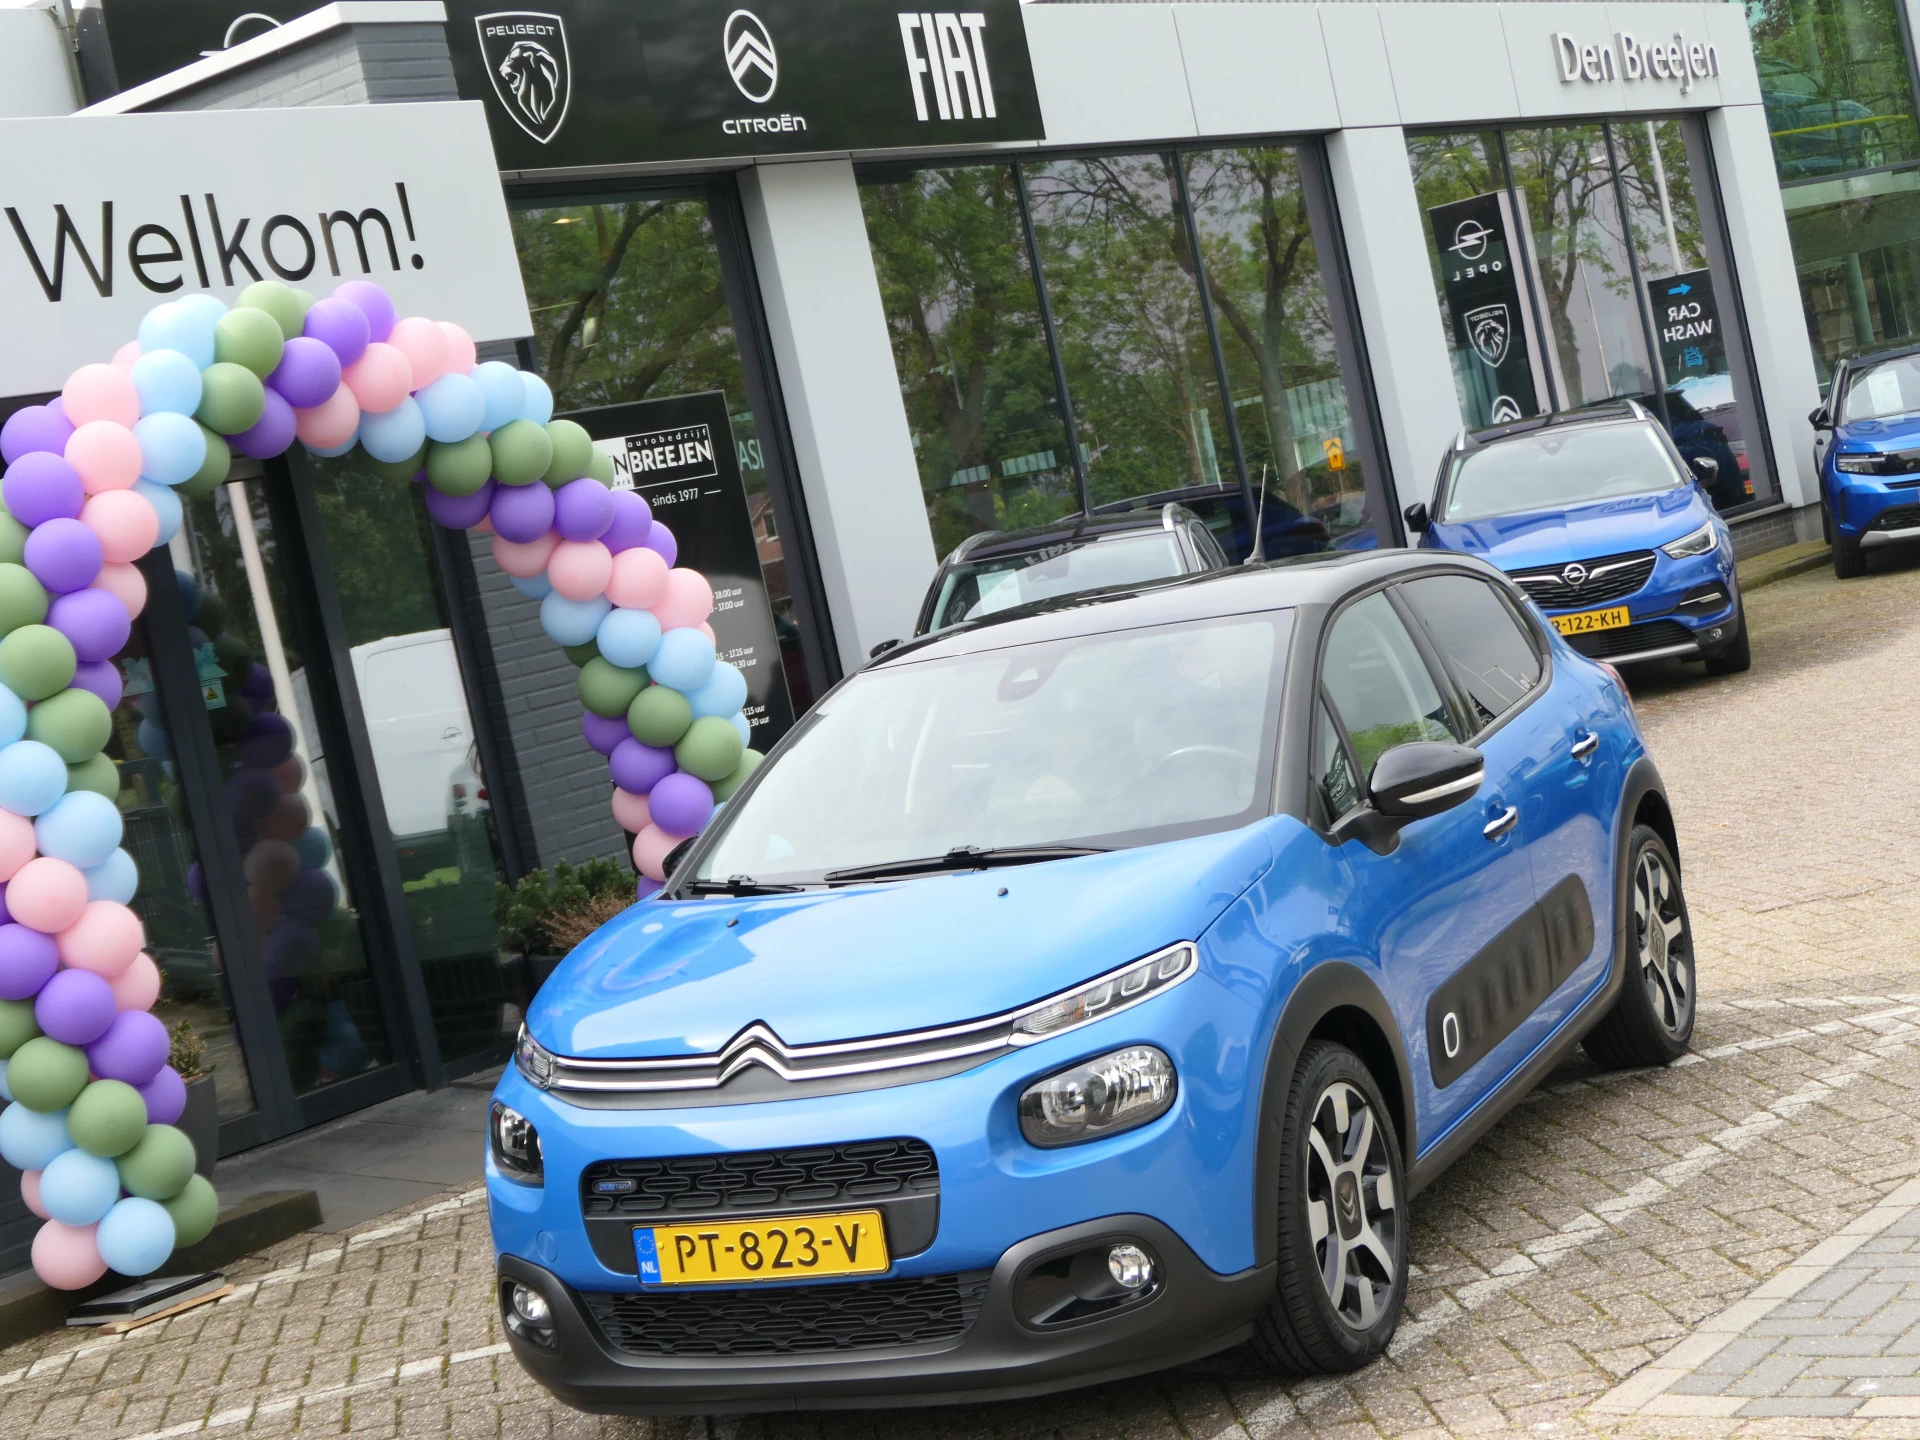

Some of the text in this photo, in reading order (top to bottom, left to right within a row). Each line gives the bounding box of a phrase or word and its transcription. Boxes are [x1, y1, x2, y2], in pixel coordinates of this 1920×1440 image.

[486, 24, 555, 38] PEUGEOT
[898, 12, 996, 121] FIAT
[1550, 29, 1721, 95] Den Breejen
[4, 182, 424, 302] Welkom!
[627, 428, 706, 448] autobedrijf
[629, 440, 712, 474] BREEJEN
[652, 488, 699, 507] sinds 1977
[714, 588, 731, 600] 18.00
[1551, 610, 1622, 633] R-122-KH
[641, 1222, 860, 1274] NL PT-823-V
